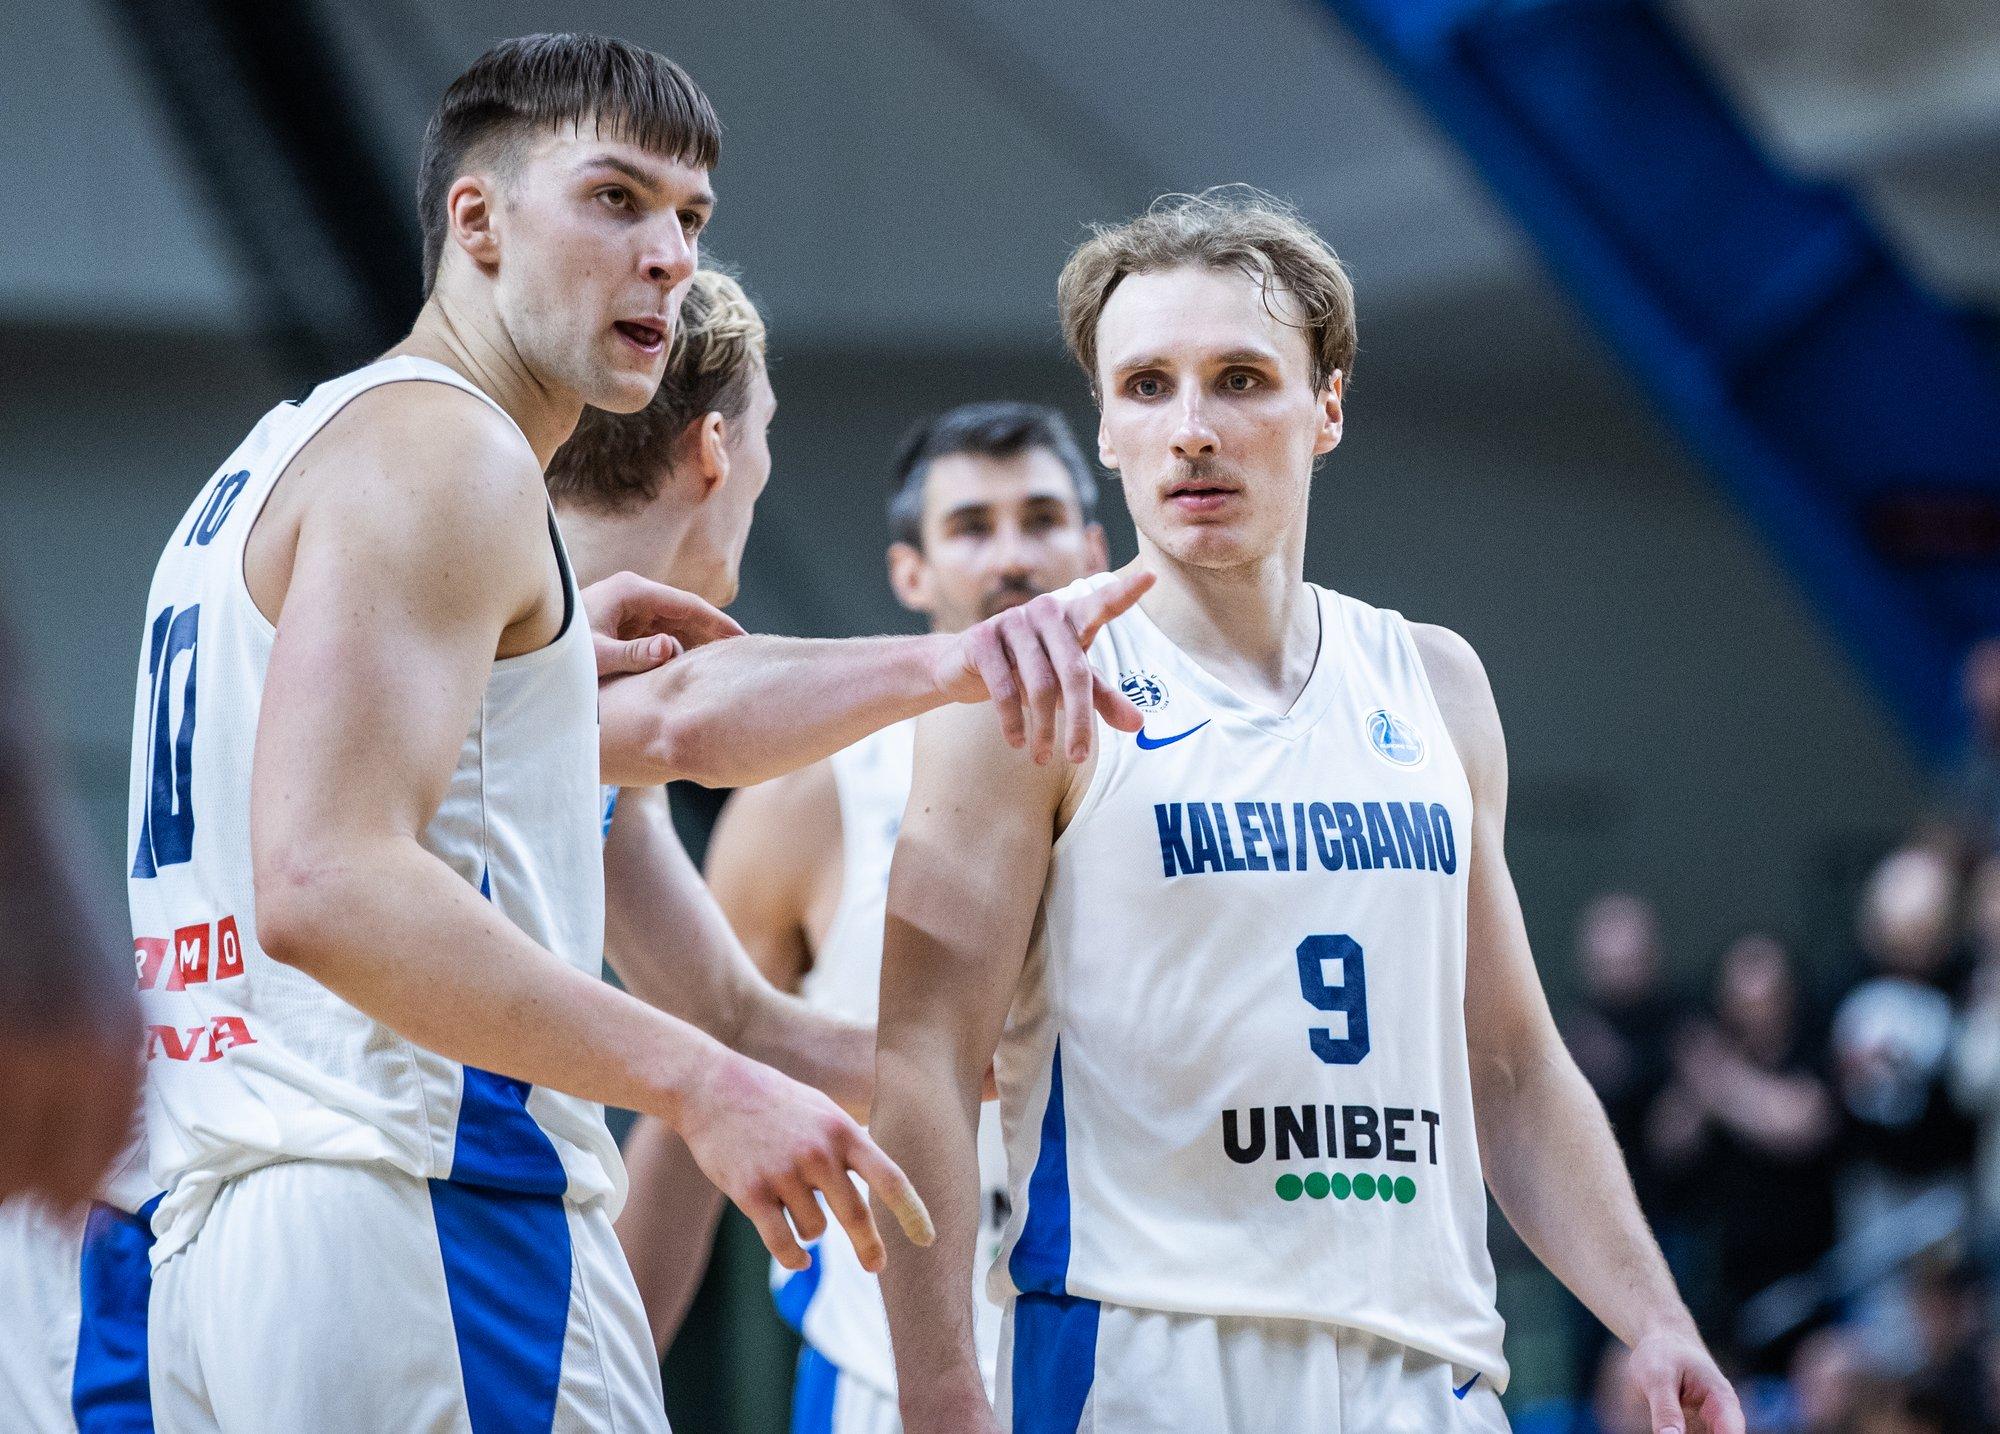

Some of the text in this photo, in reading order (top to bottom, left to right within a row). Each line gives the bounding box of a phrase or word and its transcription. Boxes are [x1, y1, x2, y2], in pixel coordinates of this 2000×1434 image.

[131, 604, 200, 879] 10
[1154, 801, 1457, 878] KALEV/CRAMO
[1296, 934, 1370, 1065] 9
[1222, 1104, 1440, 1166] UNIBET
